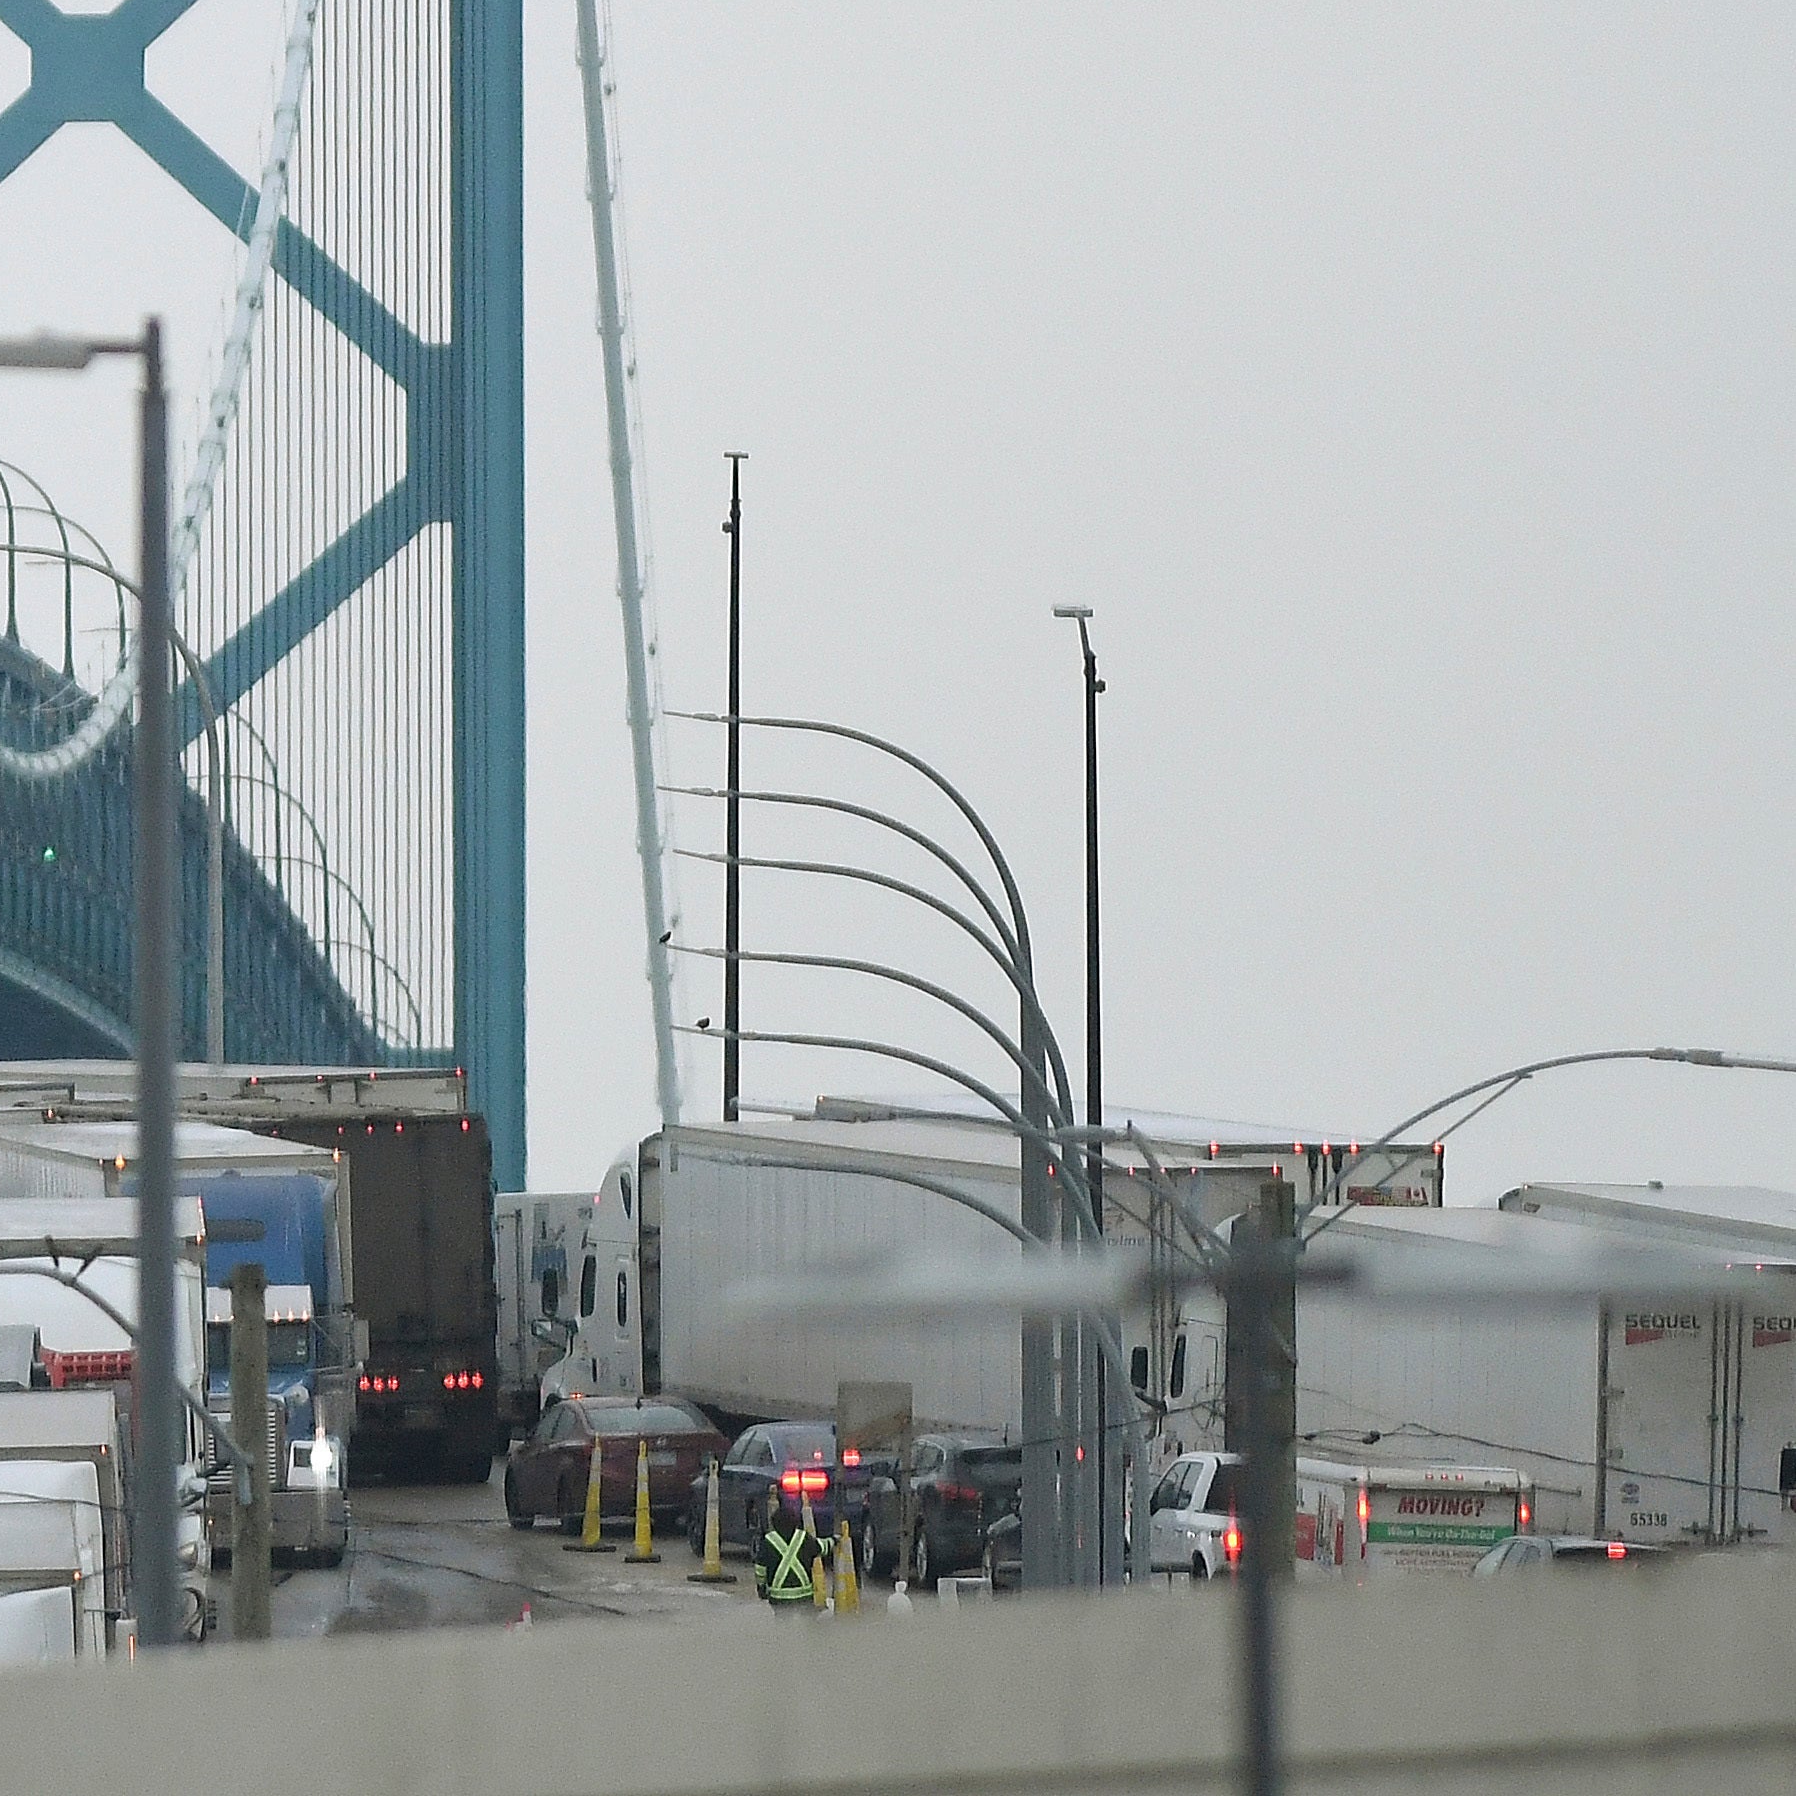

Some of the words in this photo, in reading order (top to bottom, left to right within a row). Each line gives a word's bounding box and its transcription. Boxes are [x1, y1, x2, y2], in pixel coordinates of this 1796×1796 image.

[1625, 1313, 1701, 1329] SEQUEL
[1753, 1316, 1796, 1332] SEQ
[1397, 1496, 1485, 1517] MOVING?
